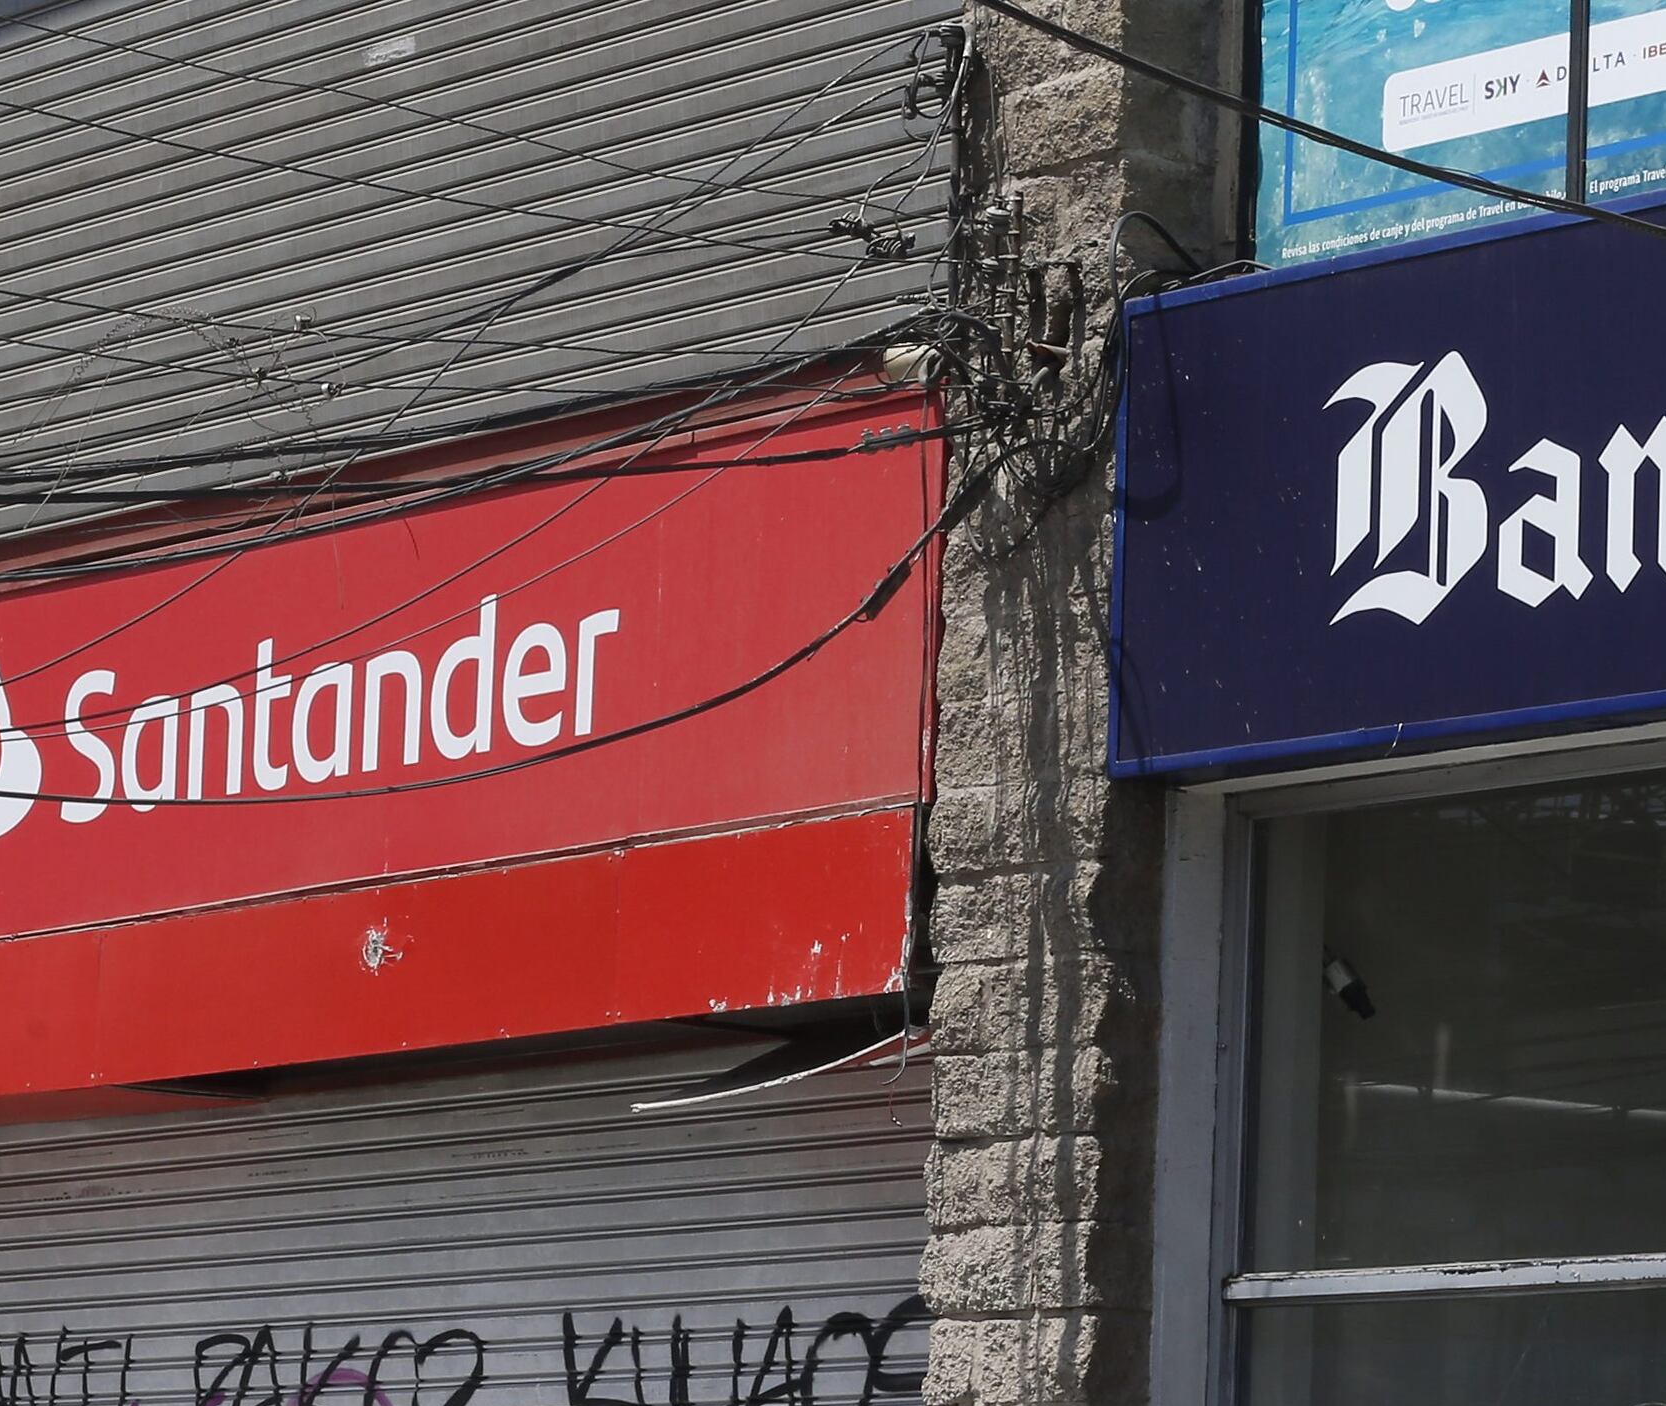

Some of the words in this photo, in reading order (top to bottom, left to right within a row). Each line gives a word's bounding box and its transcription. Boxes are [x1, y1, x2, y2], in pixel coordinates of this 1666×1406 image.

[1399, 83, 1469, 118] TRAVEL
[1556, 52, 1626, 81] DLTA
[1589, 180, 1599, 194] El
[1599, 173, 1640, 195] programa
[1281, 245, 1307, 259] Revisa
[1308, 241, 1321, 254] las
[1322, 232, 1368, 252] condiciones
[1370, 227, 1381, 241] de
[1382, 224, 1403, 240] canje
[1403, 224, 1410, 237] y
[1411, 218, 1425, 232] del
[1426, 213, 1465, 232] programa
[1466, 207, 1477, 221] de
[1478, 201, 1503, 218] Travel
[1504, 201, 1516, 213] en
[60, 594, 620, 824] Santander
